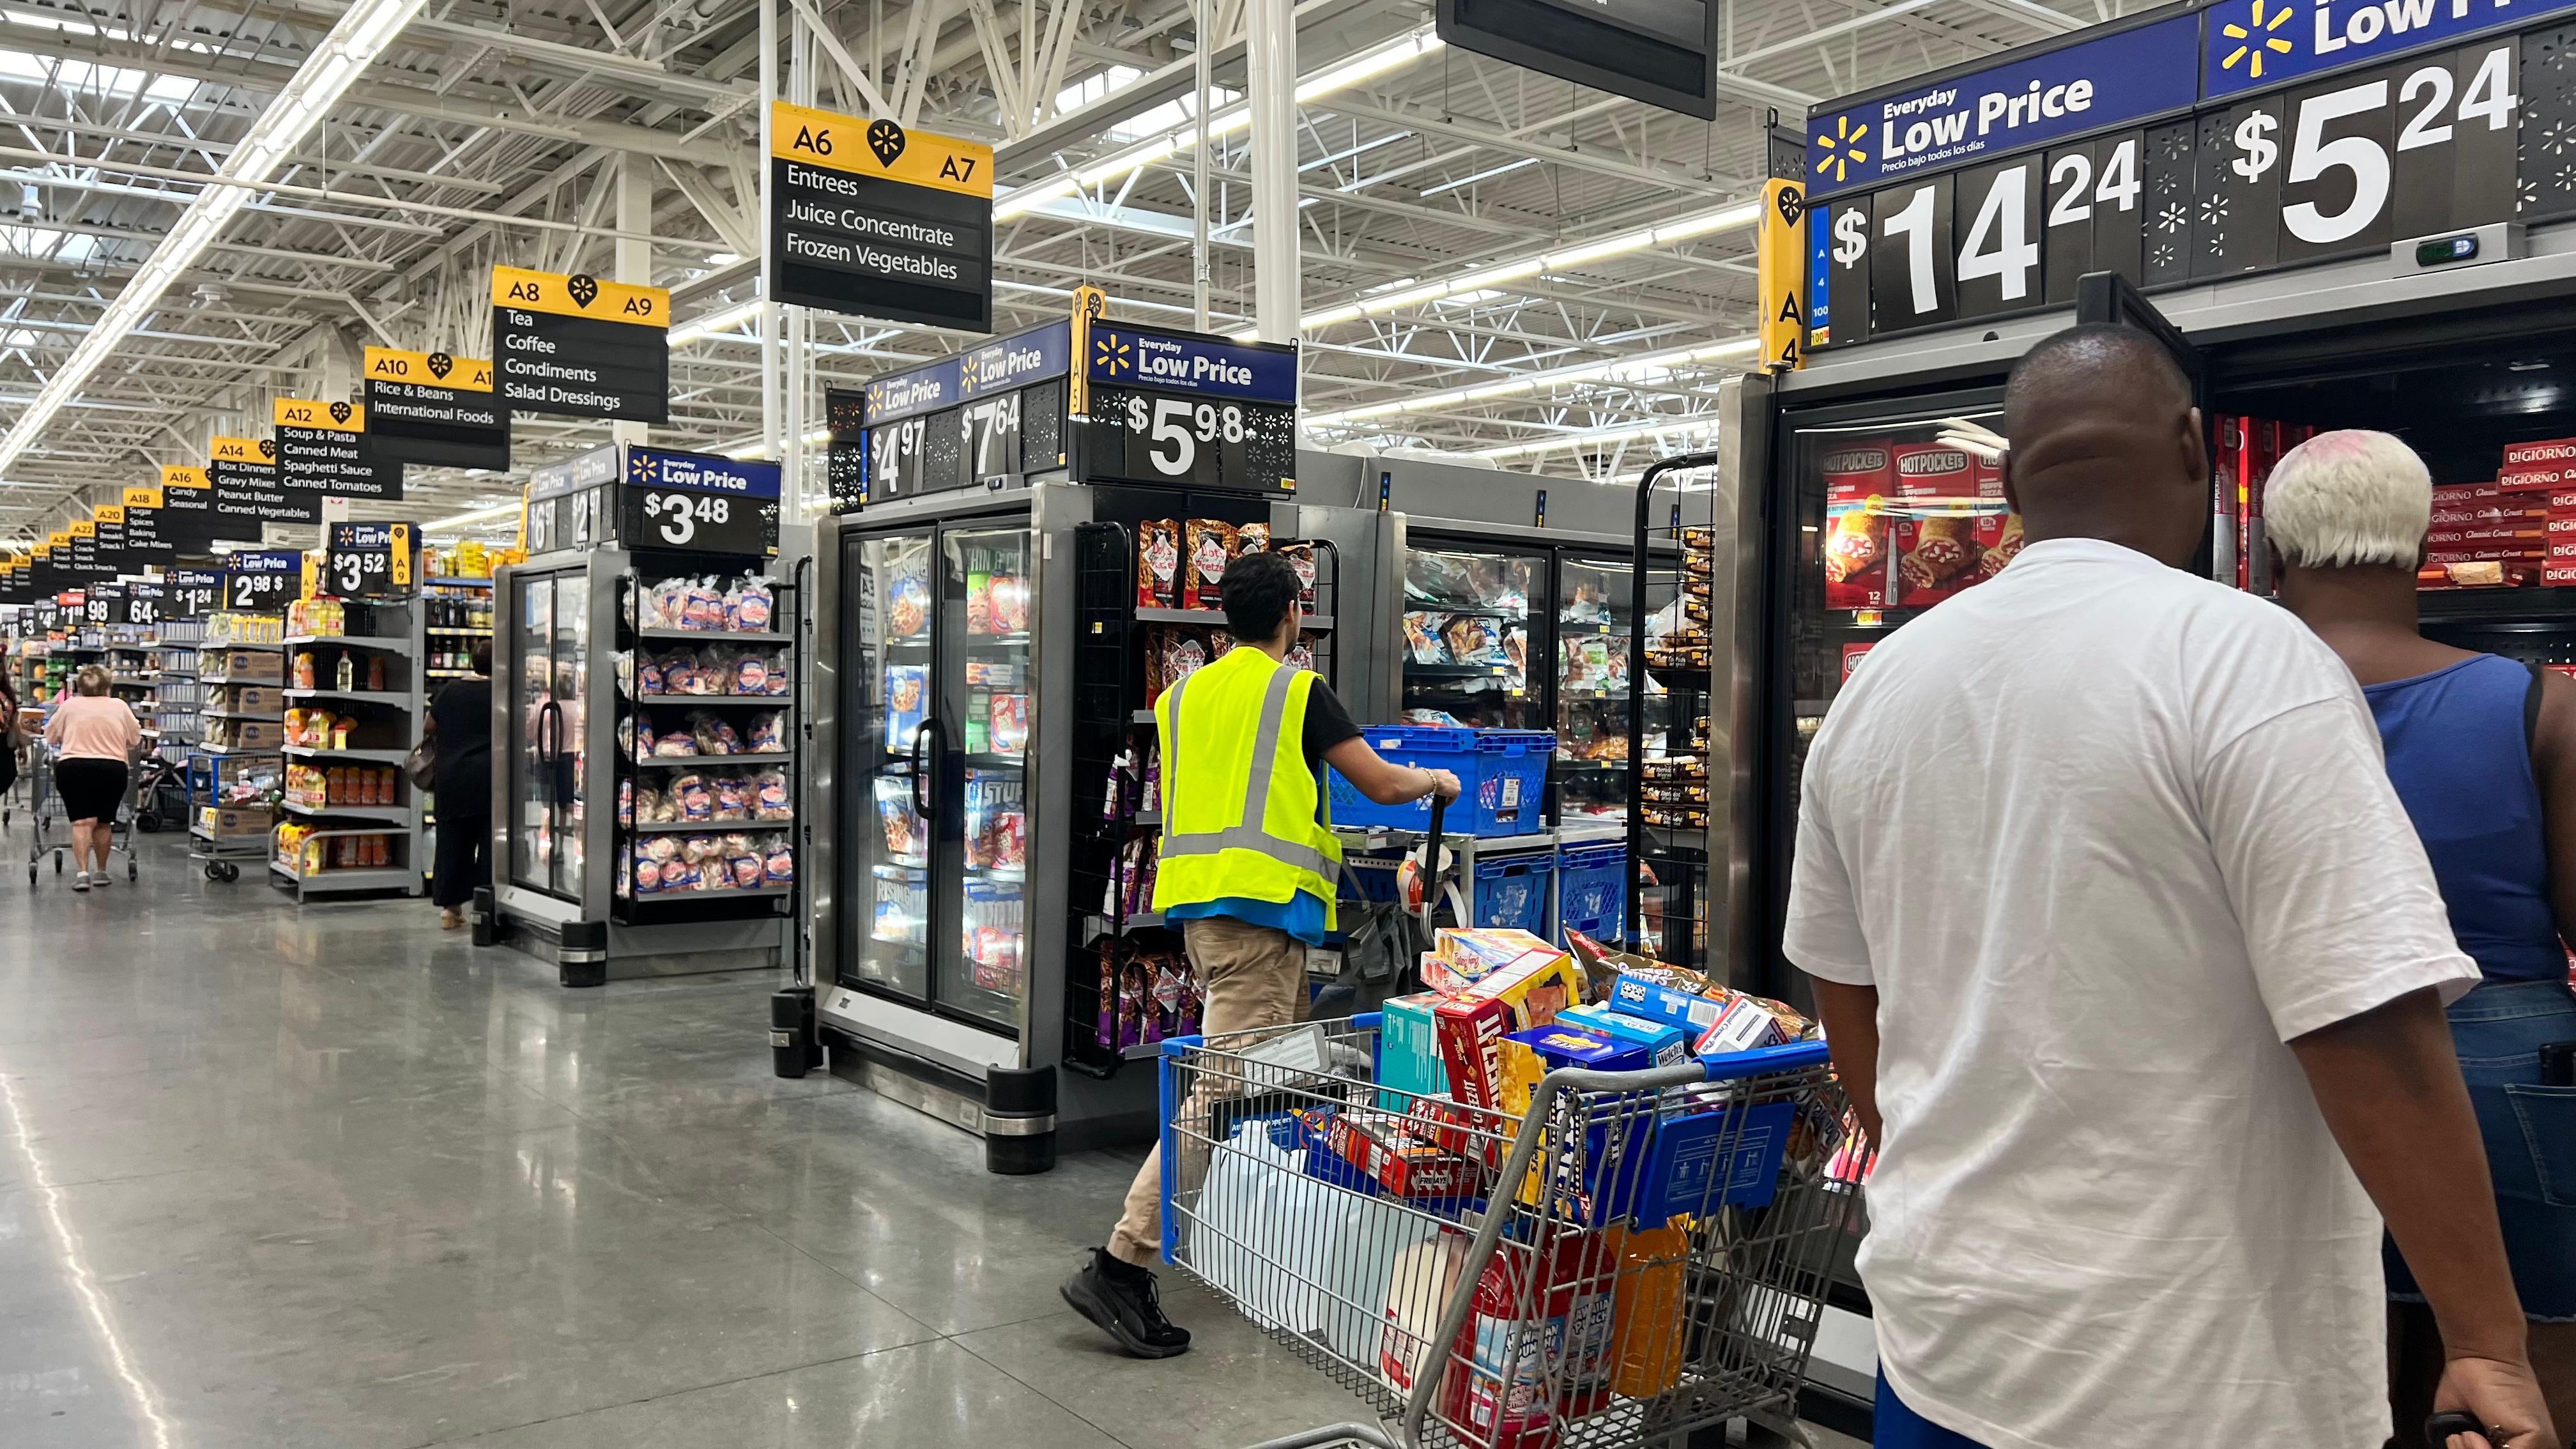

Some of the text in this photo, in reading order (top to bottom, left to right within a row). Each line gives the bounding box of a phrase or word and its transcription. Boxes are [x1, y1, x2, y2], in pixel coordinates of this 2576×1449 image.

[2315, 0, 2434, 55] Low
[1883, 88, 1957, 119] Everyday
[1882, 79, 2093, 160] Low Price
[793, 125, 832, 156] A6
[1882, 139, 1985, 173] Precio bajo todos los días
[939, 155, 976, 183] A7
[788, 164, 857, 195] Entrees
[787, 199, 954, 247] Juice Concentrate
[787, 233, 957, 280] Frozen Vegetables
[1818, 249, 1825, 259] A
[1818, 276, 1825, 286] 4
[508, 281, 540, 302] A8
[623, 296, 652, 316] A9
[1779, 290, 1802, 325] A
[1813, 305, 1828, 318] 100
[507, 309, 533, 326] Tea
[505, 334, 556, 354] Coffee
[1138, 337, 1182, 354] Everyday
[1811, 332, 1823, 344] 100
[981, 346, 1004, 359] Everyday
[1781, 337, 1798, 369] 4
[374, 358, 408, 375] A10
[505, 358, 597, 383] Condiments
[980, 347, 1041, 384] Low Price
[1073, 360, 1080, 379] A
[1138, 349, 1252, 385] Low Price
[473, 370, 492, 385] A1
[886, 377, 908, 390] Everyday
[1138, 374, 1153, 383] Precio
[374, 381, 454, 401] Rice & Beans
[505, 382, 621, 411] Salad Dressings
[885, 379, 941, 410] Low Price
[1073, 389, 1078, 407] 5
[285, 408, 312, 422] A12
[374, 401, 494, 424] International Foods
[284, 427, 356, 443] Soup & Pasta
[218, 445, 243, 457] A14
[284, 443, 358, 459] Canned Meat
[2508, 446, 2576, 463] DIGIORNO
[218, 461, 276, 474] Box Dinners
[284, 459, 373, 476] Spaghetti Sauce
[592, 460, 606, 476] Price
[663, 459, 696, 470] Everyday
[1823, 452, 1883, 471] HOT POCKETS
[1900, 458, 1919, 473] HOT
[1920, 454, 1965, 472] POCKETS
[170, 473, 191, 482] A16
[218, 475, 275, 489] Gravy Mixes
[284, 476, 382, 493] Canned Tomatoes
[549, 473, 564, 489] Price
[663, 466, 747, 490] Low Price
[2501, 473, 2559, 486] DIGIORNO
[130, 494, 150, 503] A18
[169, 487, 197, 497] Candy
[218, 489, 284, 503] Peanut Butter
[2432, 491, 2471, 502] GIORNO
[169, 500, 207, 509] Seasonal
[2552, 495, 2576, 506] DIGI
[129, 507, 151, 516] Sugar
[218, 503, 310, 518] Canned Vegetables
[2432, 512, 2472, 523] GIORNO
[2477, 510, 2502, 518] Classic
[129, 518, 154, 526] Spices
[129, 529, 156, 538] Baking
[356, 531, 391, 546] Low Pri
[2428, 529, 2513, 542] IORNO Classic Crust
[243, 557, 287, 569] Low Price
[396, 558, 406, 569] A
[1195, 560, 1225, 572] Pretze
[195, 574, 215, 584] Price
[398, 572, 404, 581] 9
[1868, 591, 1881, 601] 12
[88, 600, 108, 622] 98
[877, 880, 910, 901] RISING
[1681, 980, 1703, 993] 32
[1727, 1001, 1747, 1027] Oatmeal
[1657, 1041, 1683, 1066] Welch's
[1701, 1040, 1716, 1053] Pies
[1580, 1194, 1591, 1211] 12
